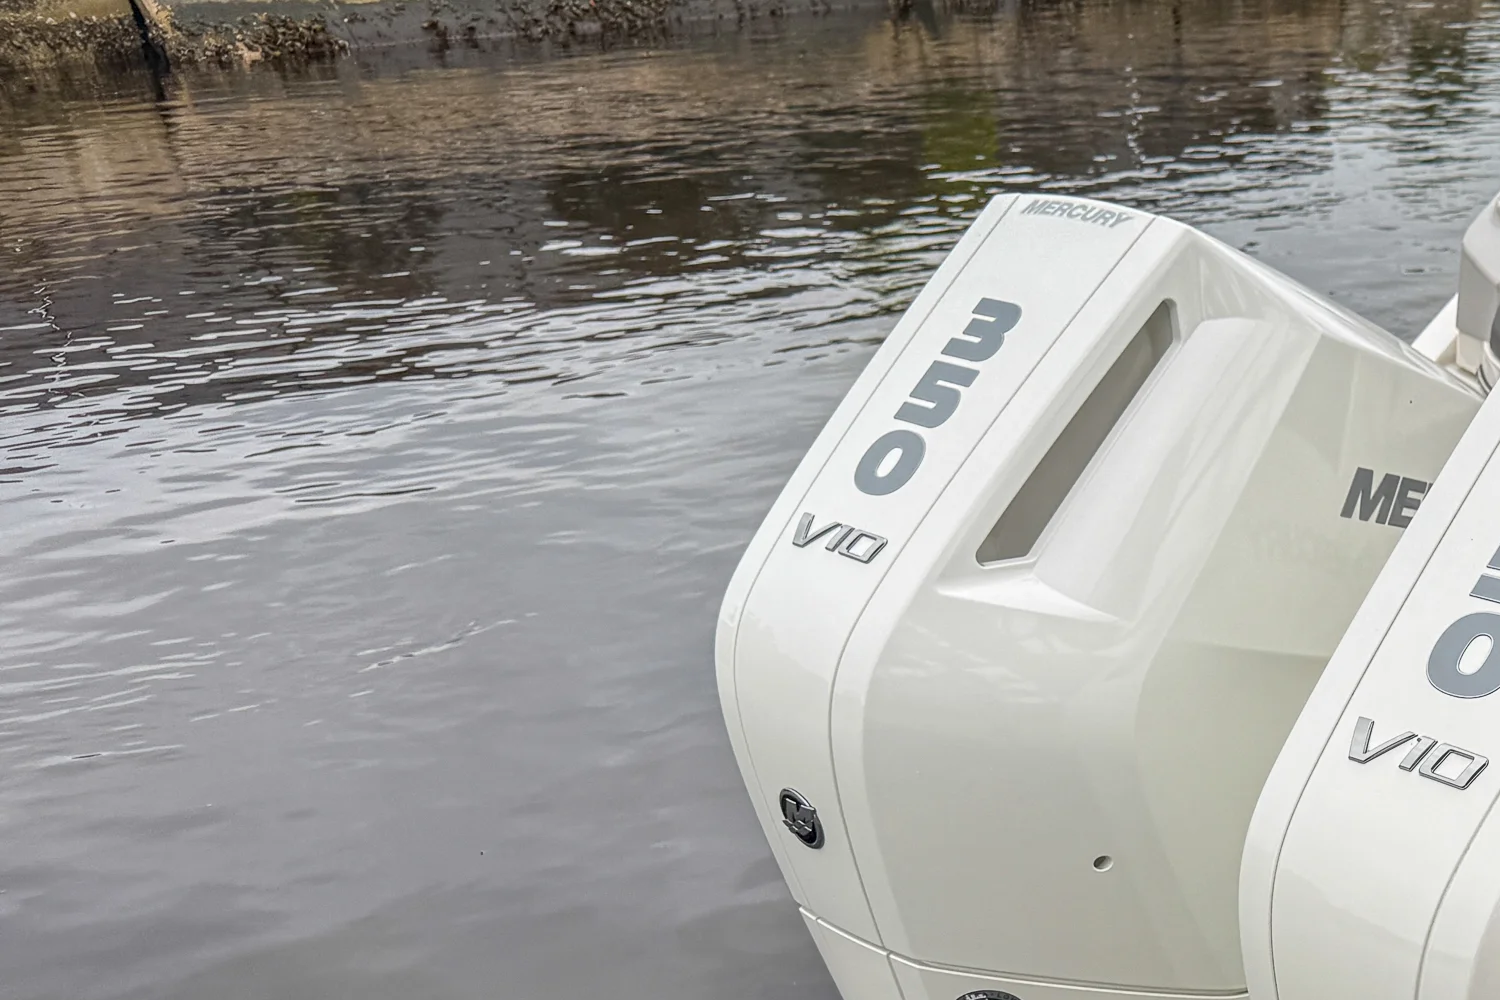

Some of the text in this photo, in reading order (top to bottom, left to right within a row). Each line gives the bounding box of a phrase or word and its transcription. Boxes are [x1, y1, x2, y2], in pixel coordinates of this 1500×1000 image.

[1021, 199, 1134, 228] MERCURY
[854, 297, 1022, 496] 350
[1340, 466, 1433, 529] ME
[792, 512, 888, 564] V10
[1348, 716, 1490, 790] V10
